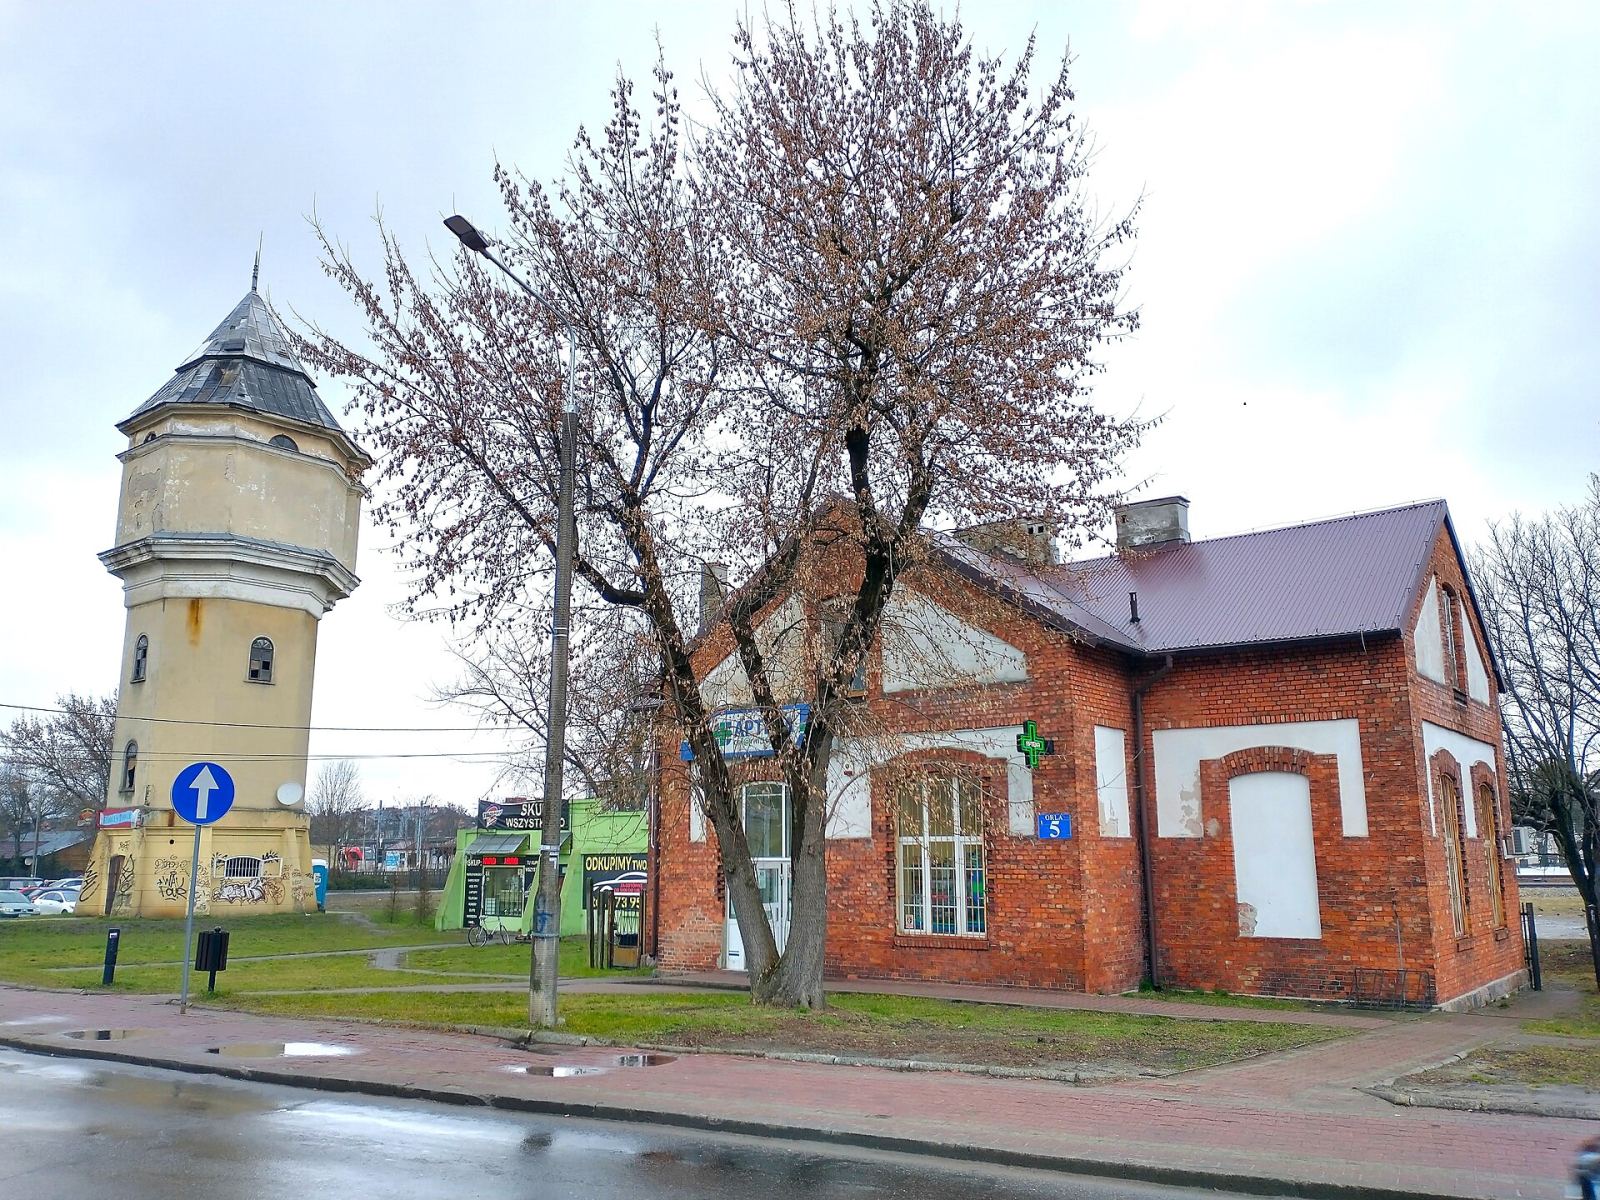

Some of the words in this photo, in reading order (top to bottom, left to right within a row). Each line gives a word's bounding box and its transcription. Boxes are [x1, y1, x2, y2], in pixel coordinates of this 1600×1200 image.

[520, 803, 542, 817] SKU
[1049, 821, 1060, 838] 5
[585, 856, 632, 871] ODKUPIMY
[632, 859, 648, 870] TWO
